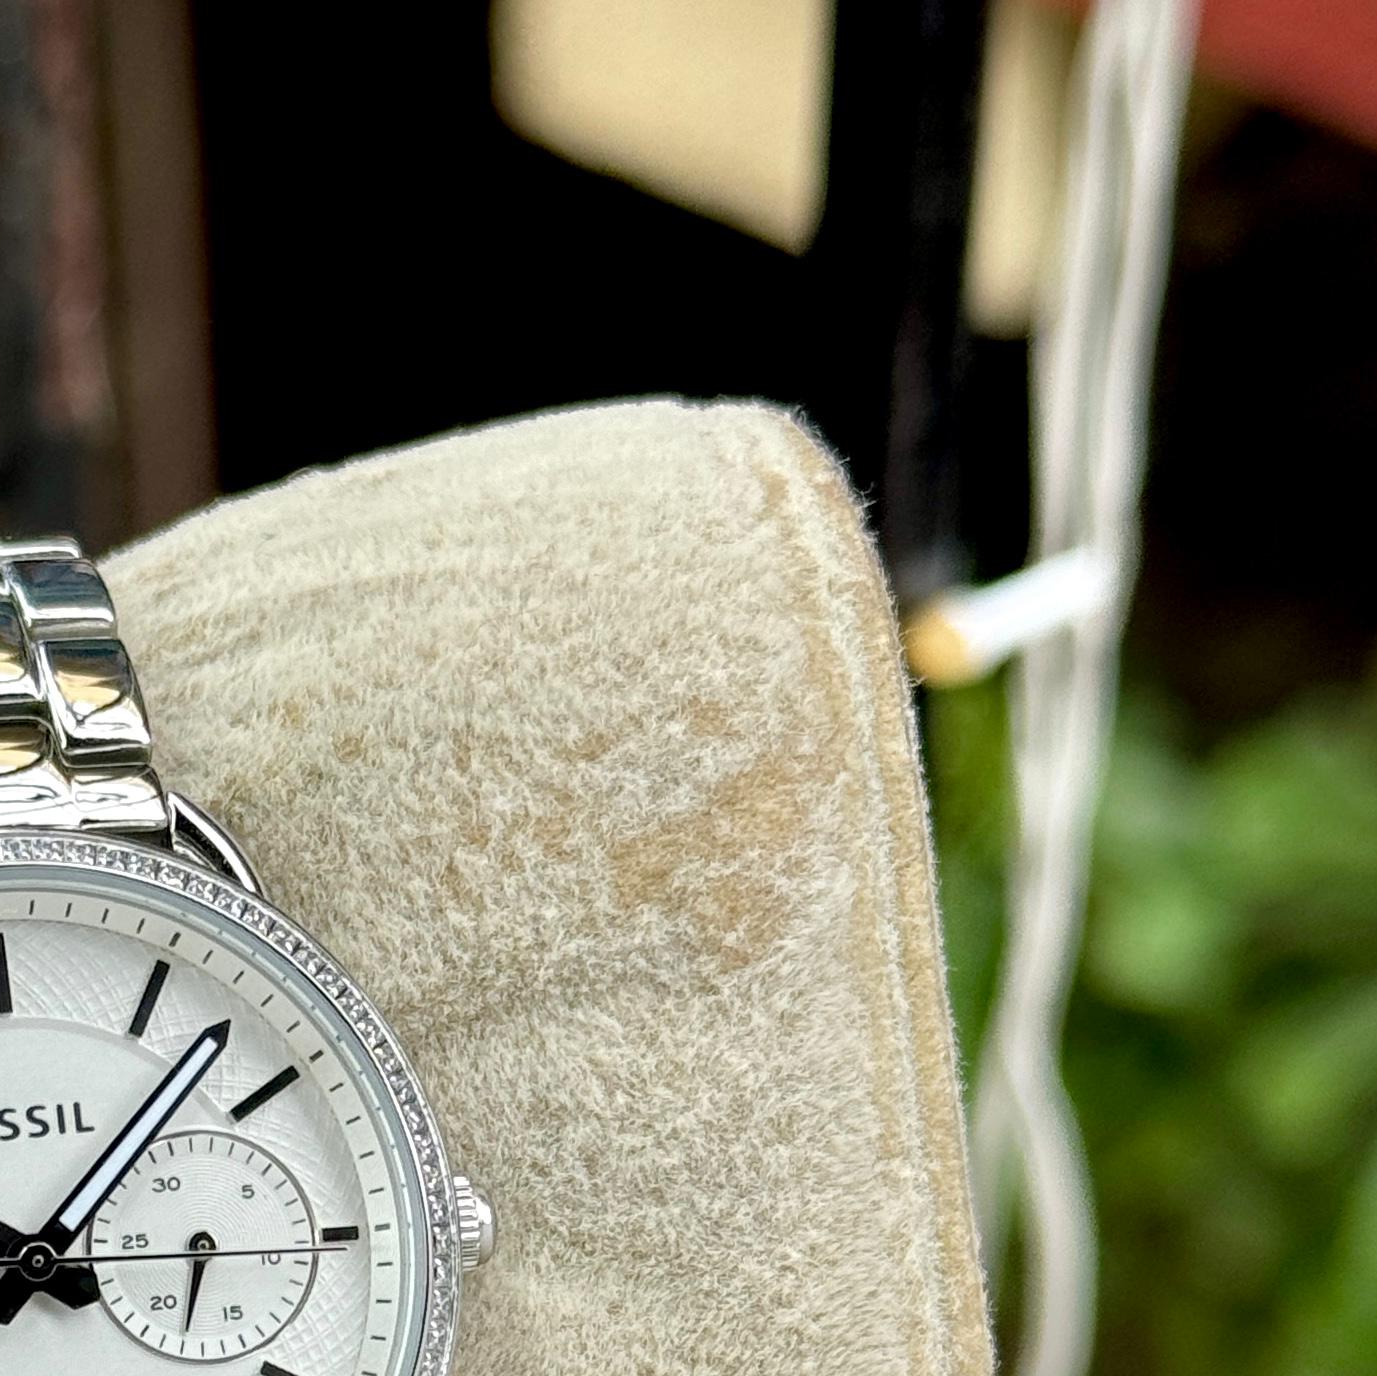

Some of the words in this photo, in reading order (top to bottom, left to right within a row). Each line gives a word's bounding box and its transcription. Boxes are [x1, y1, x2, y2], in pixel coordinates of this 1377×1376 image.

[151, 1176, 181, 1193] 30
[241, 1184, 255, 1199] 5
[121, 1233, 149, 1250] 25
[149, 1294, 178, 1311] 20
[223, 1305, 243, 1322] 15
